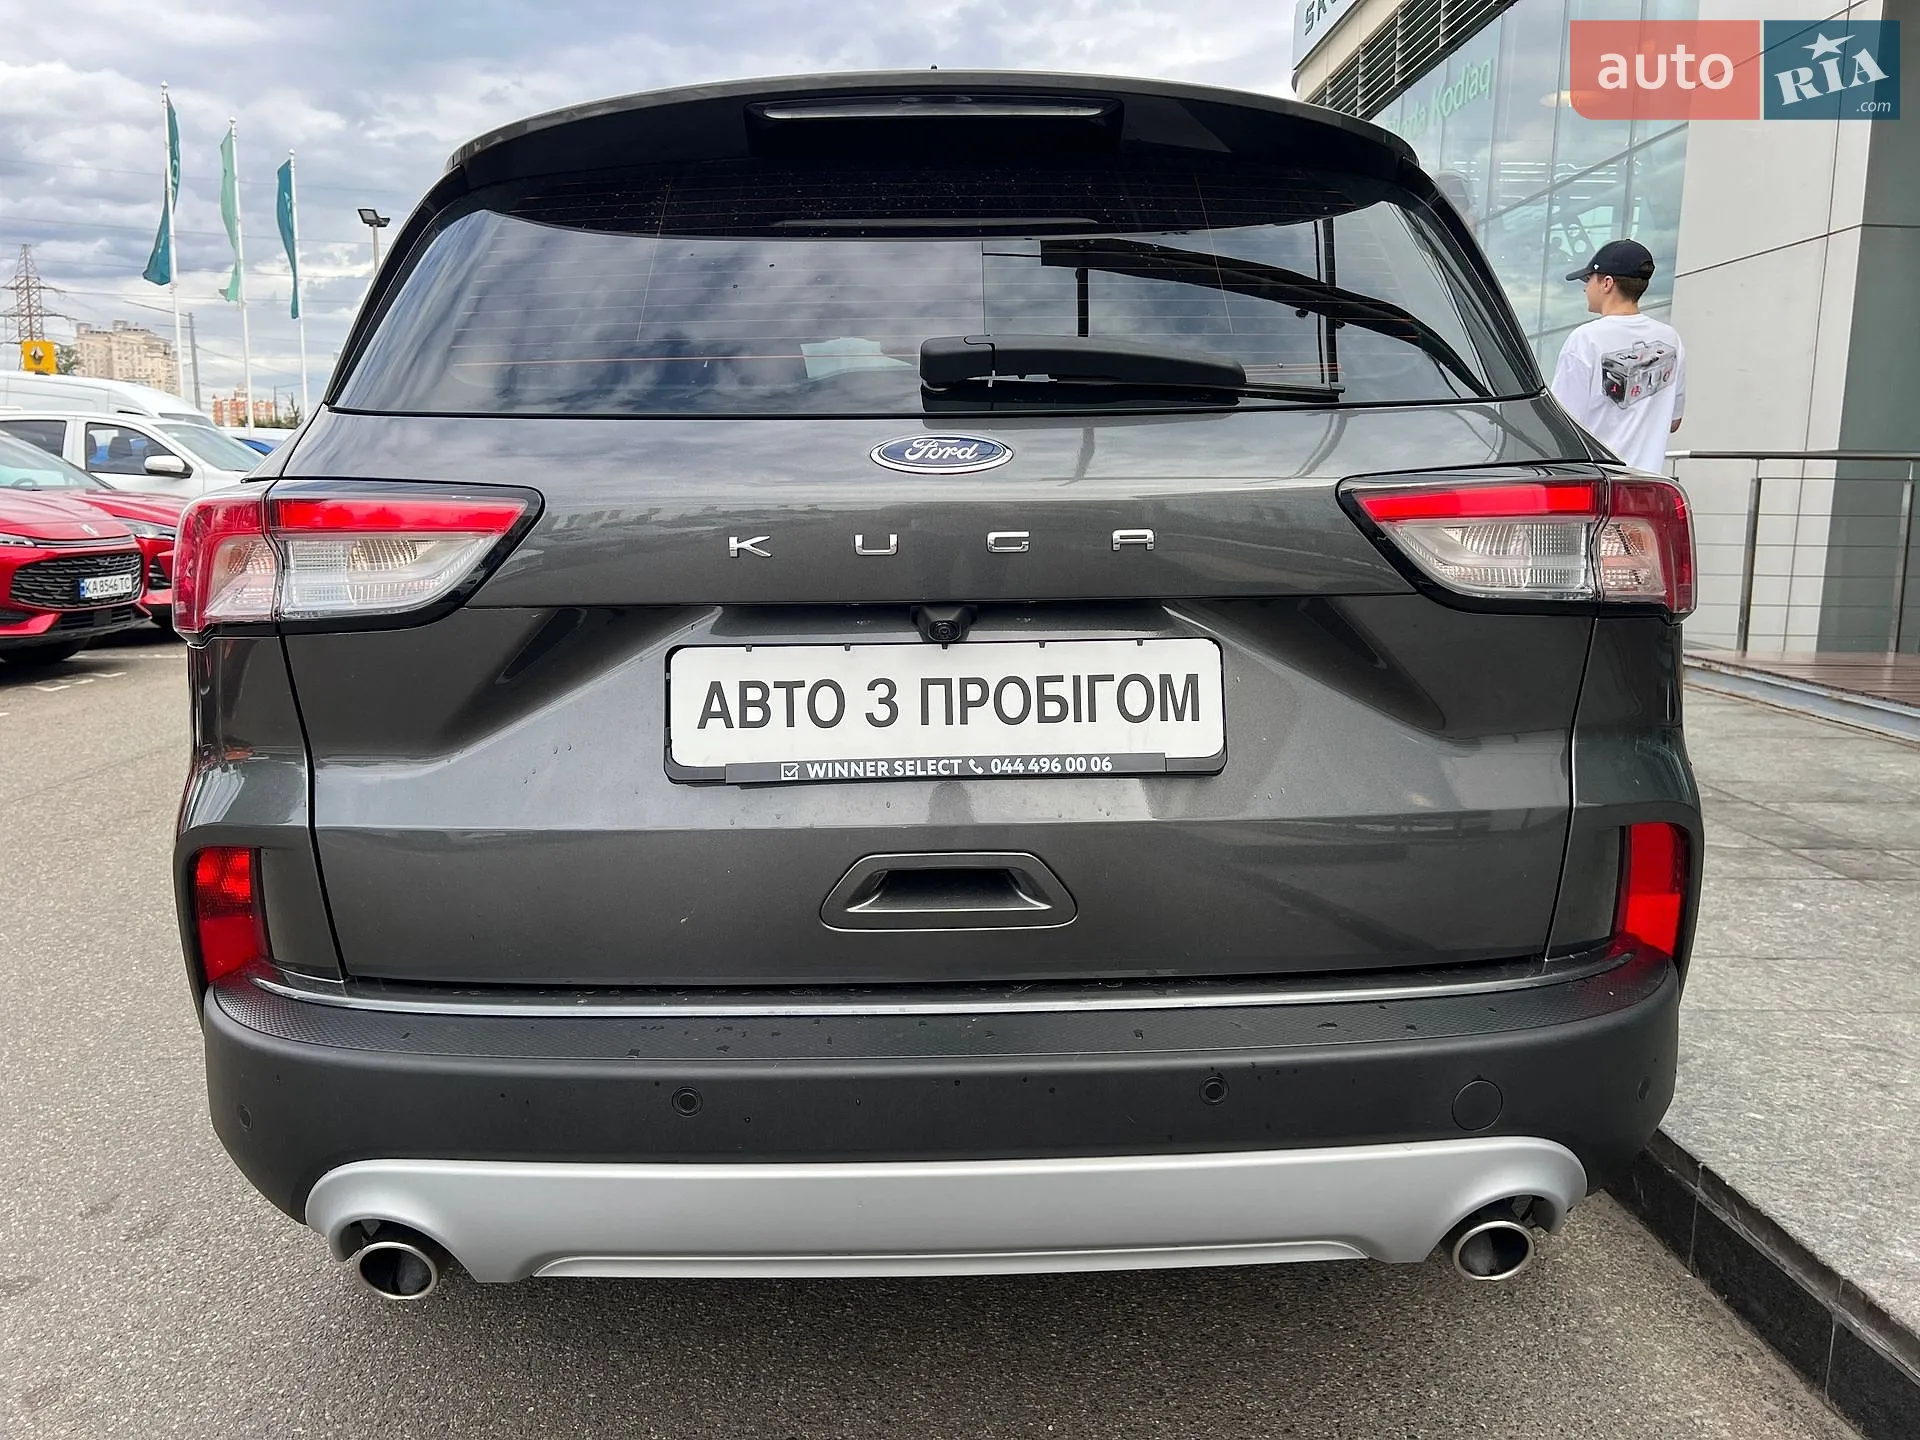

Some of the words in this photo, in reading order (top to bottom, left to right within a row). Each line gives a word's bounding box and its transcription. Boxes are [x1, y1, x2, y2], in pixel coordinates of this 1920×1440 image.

[904, 438, 979, 461] Ford
[728, 528, 1156, 558] KUGA
[697, 678, 846, 730] АВТО
[920, 672, 1200, 727] ПРОБІГОМ
[806, 761, 890, 779] WINNER
[893, 758, 963, 777] SELECT
[990, 757, 1025, 775] 044
[1027, 756, 1062, 774] 496
[1065, 755, 1088, 773] 00
[1090, 755, 1113, 773] 06
